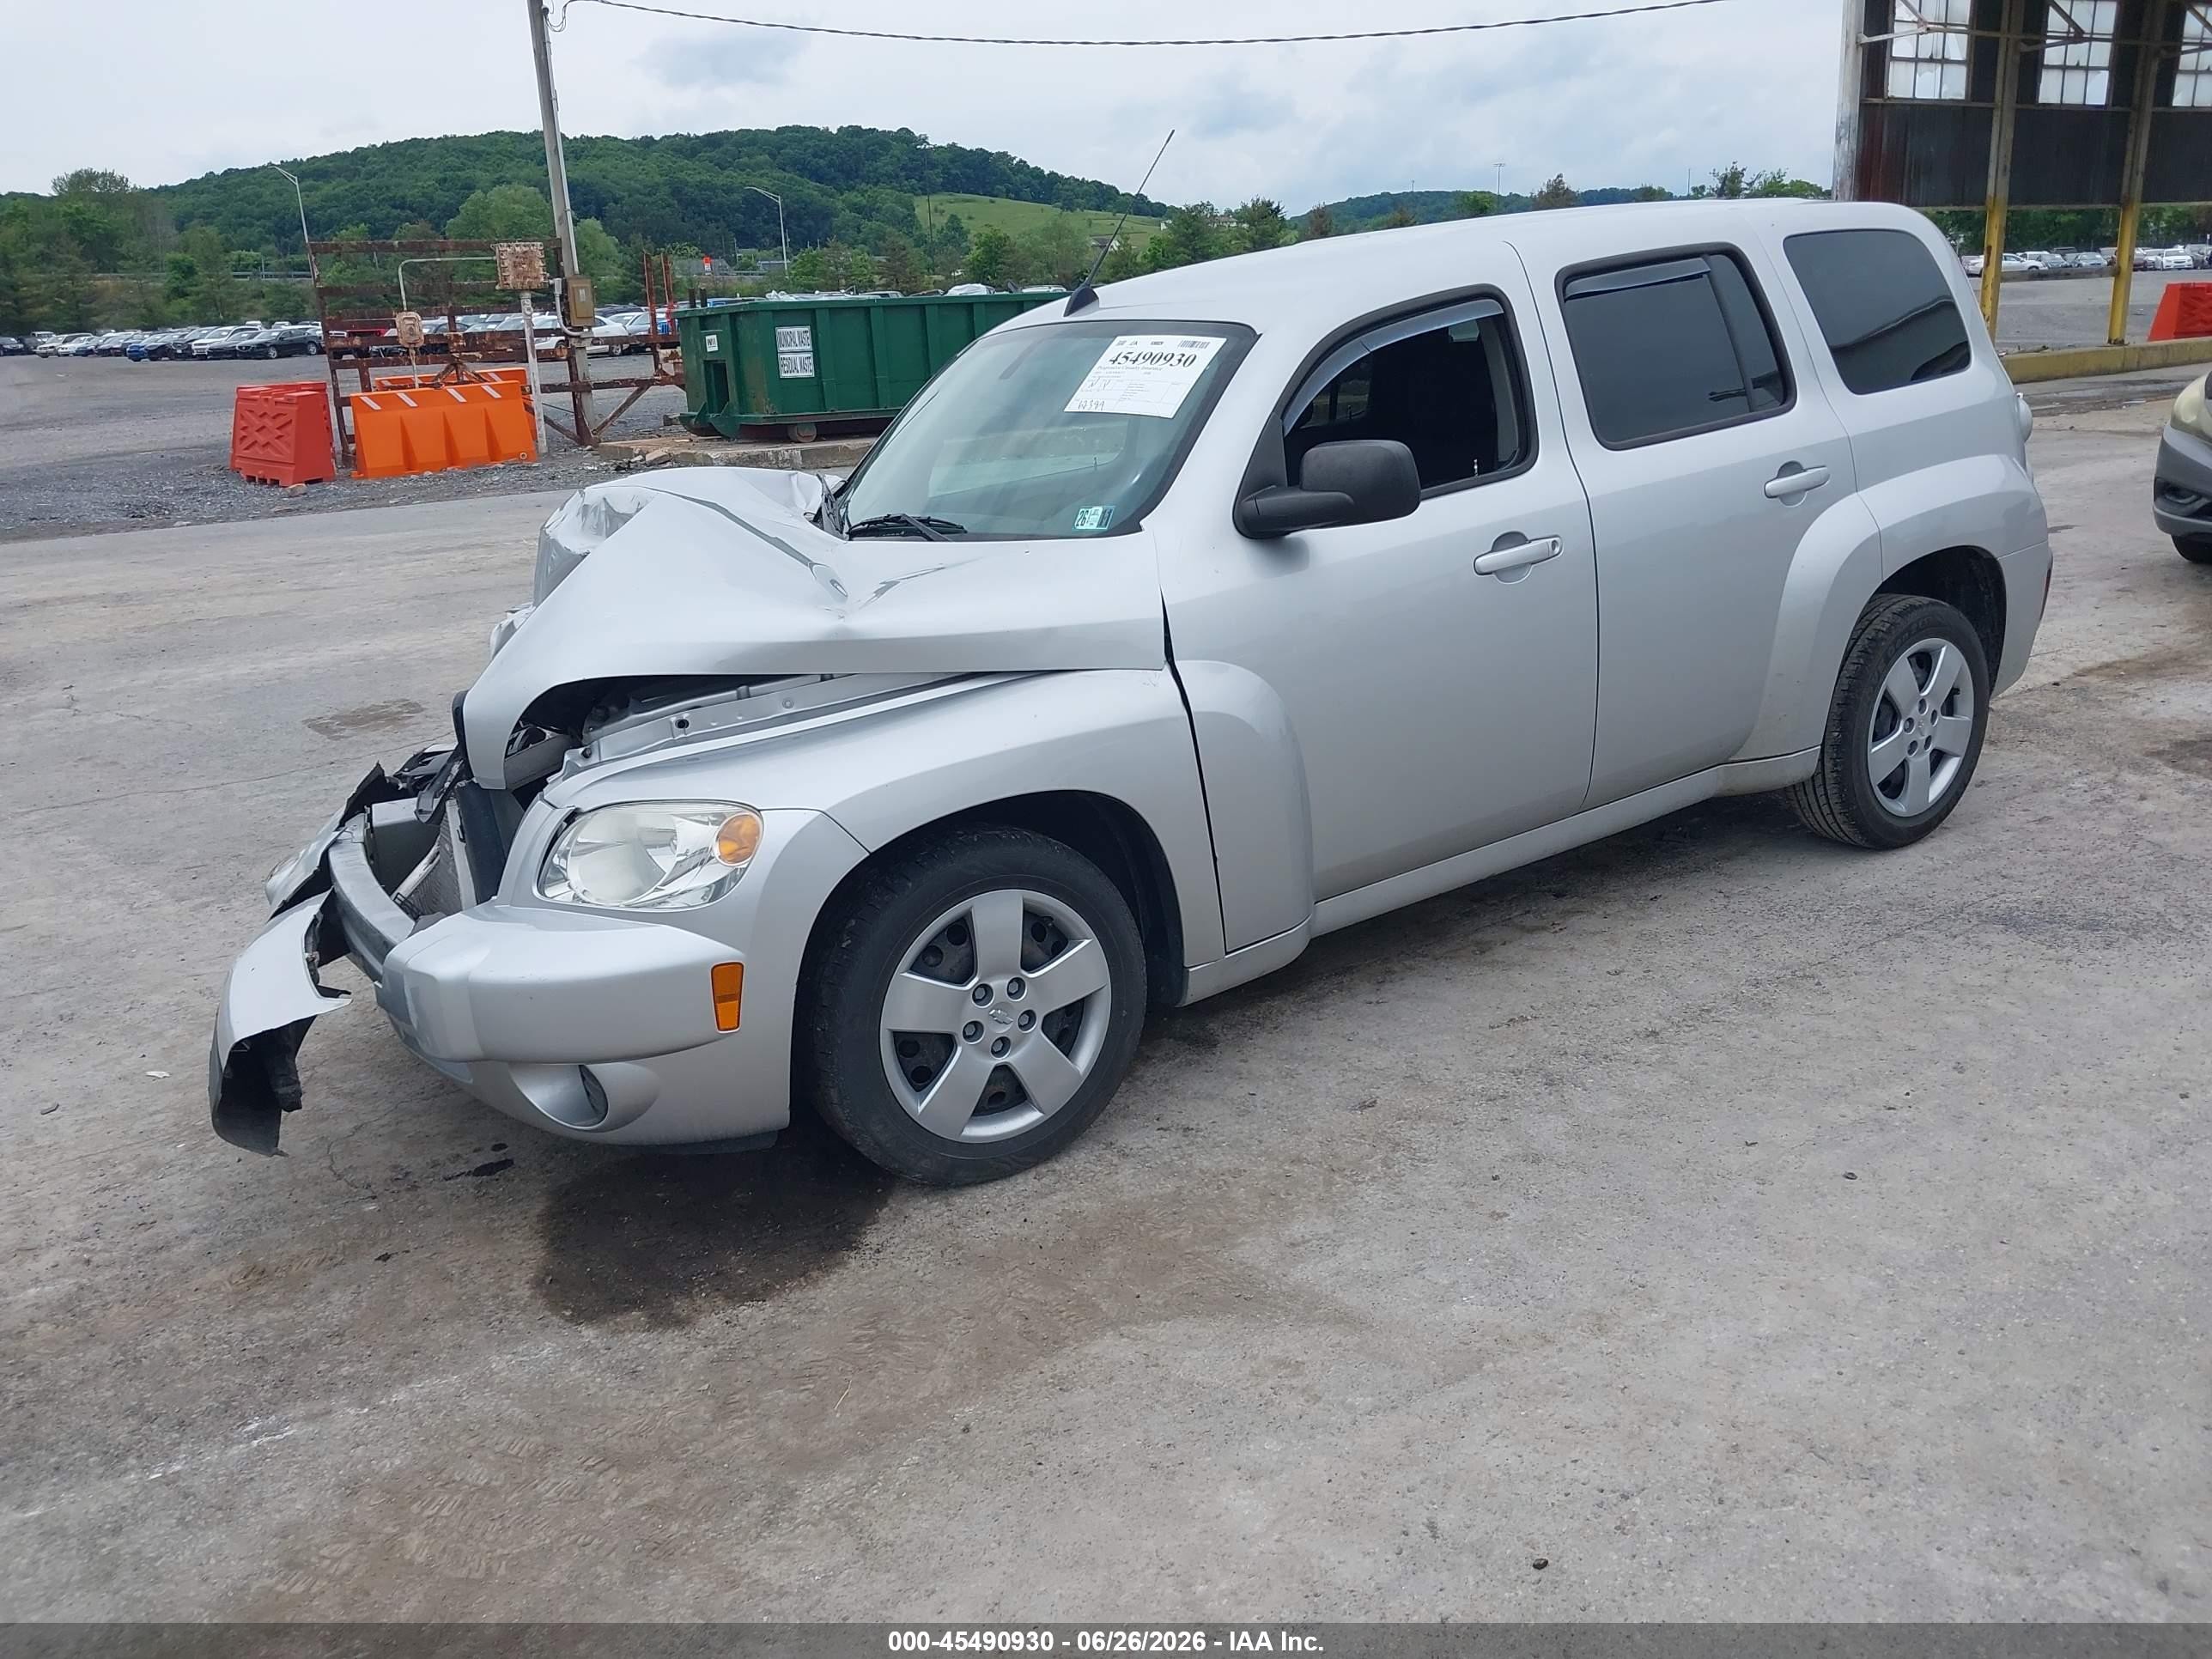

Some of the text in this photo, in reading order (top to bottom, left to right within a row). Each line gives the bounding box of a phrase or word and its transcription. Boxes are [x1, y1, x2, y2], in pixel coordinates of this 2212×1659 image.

[798, 330, 811, 347] WASTE
[781, 356, 812, 374] RESIDUAL WASTE
[1109, 351, 1198, 368] 45490930
